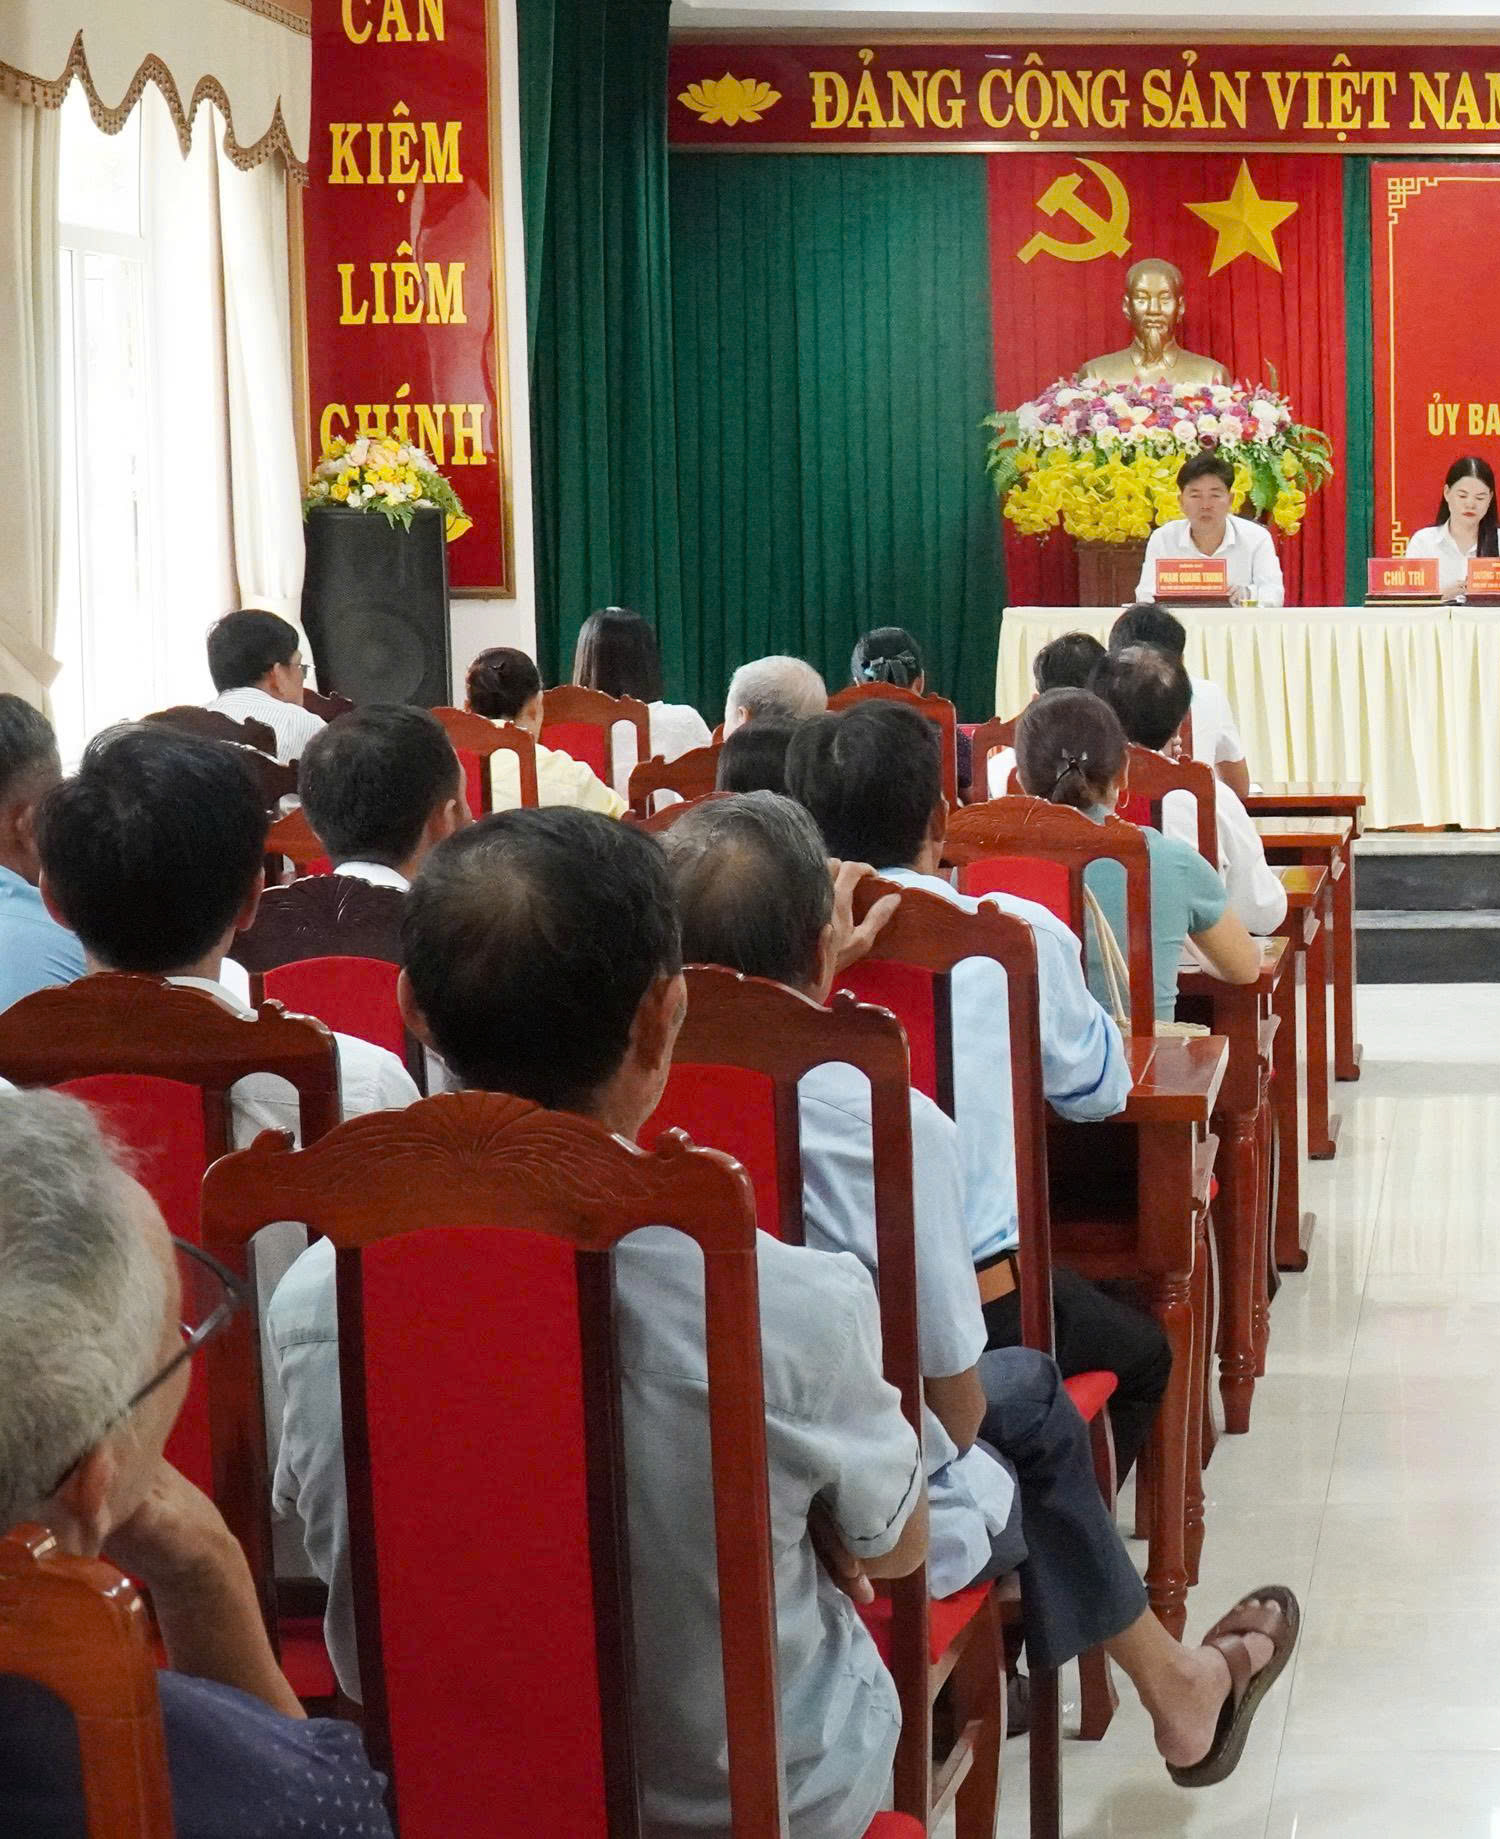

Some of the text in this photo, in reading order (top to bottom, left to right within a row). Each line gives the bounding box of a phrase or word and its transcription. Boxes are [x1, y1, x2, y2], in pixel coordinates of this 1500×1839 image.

[810, 48, 963, 130] ĐẢNG
[978, 53, 1129, 142] CỘNG
[1143, 49, 1250, 129] SẢN
[1262, 54, 1396, 141] VIỆT
[328, 100, 463, 203] KIỆM
[337, 241, 468, 324] LIÊM
[1428, 392, 1460, 436] ỦY
[1384, 566, 1406, 586] CHỦ
